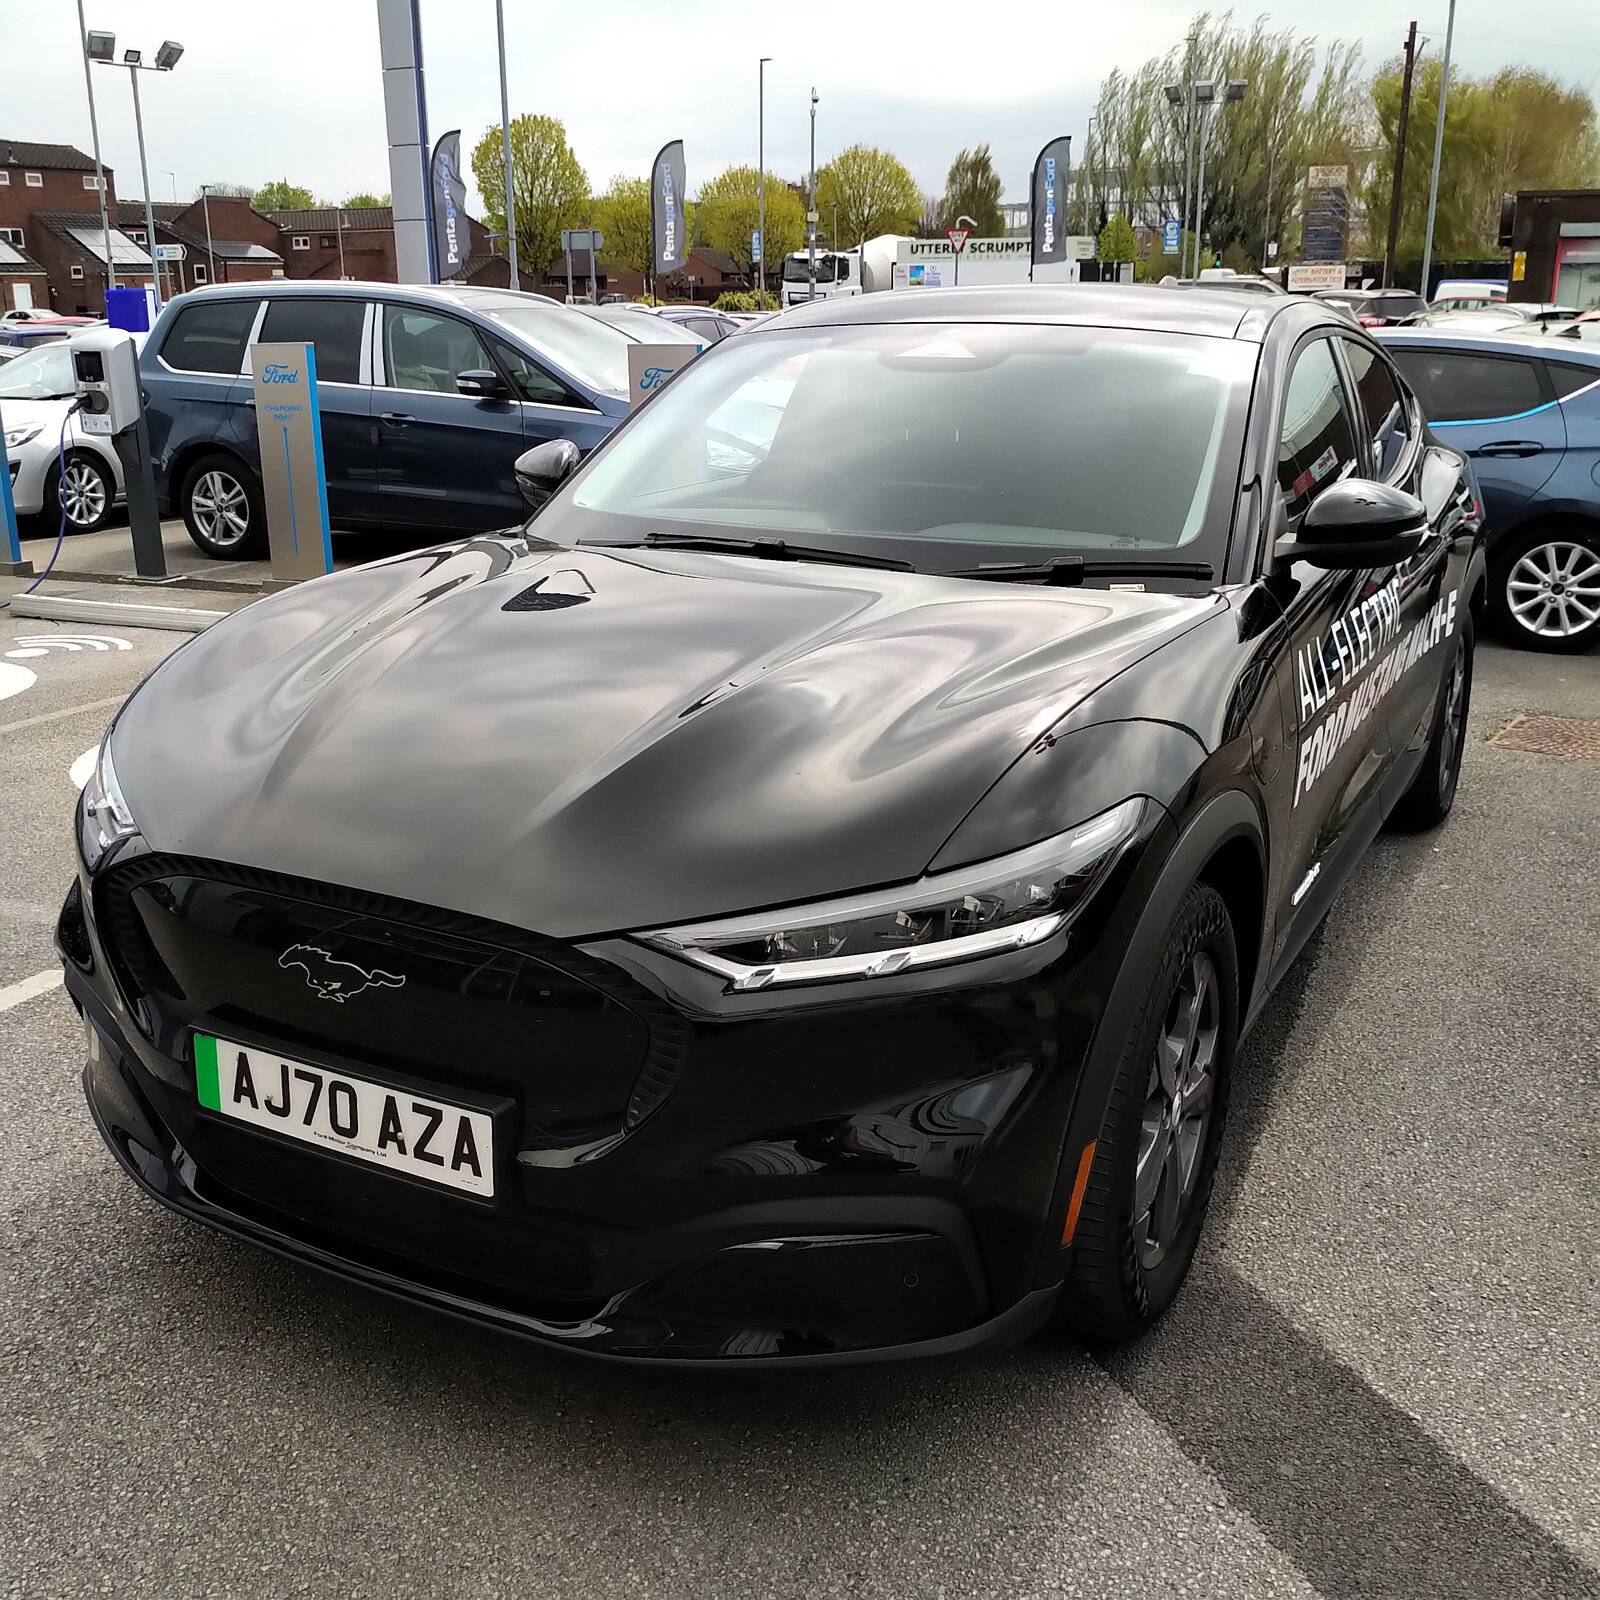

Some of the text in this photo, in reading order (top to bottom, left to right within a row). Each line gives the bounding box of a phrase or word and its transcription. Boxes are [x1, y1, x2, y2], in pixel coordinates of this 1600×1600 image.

[262, 364, 298, 384] Ford
[640, 367, 674, 390] Fo
[1293, 701, 1347, 809] FORD
[233, 1052, 483, 1178] AJ70 AZA
